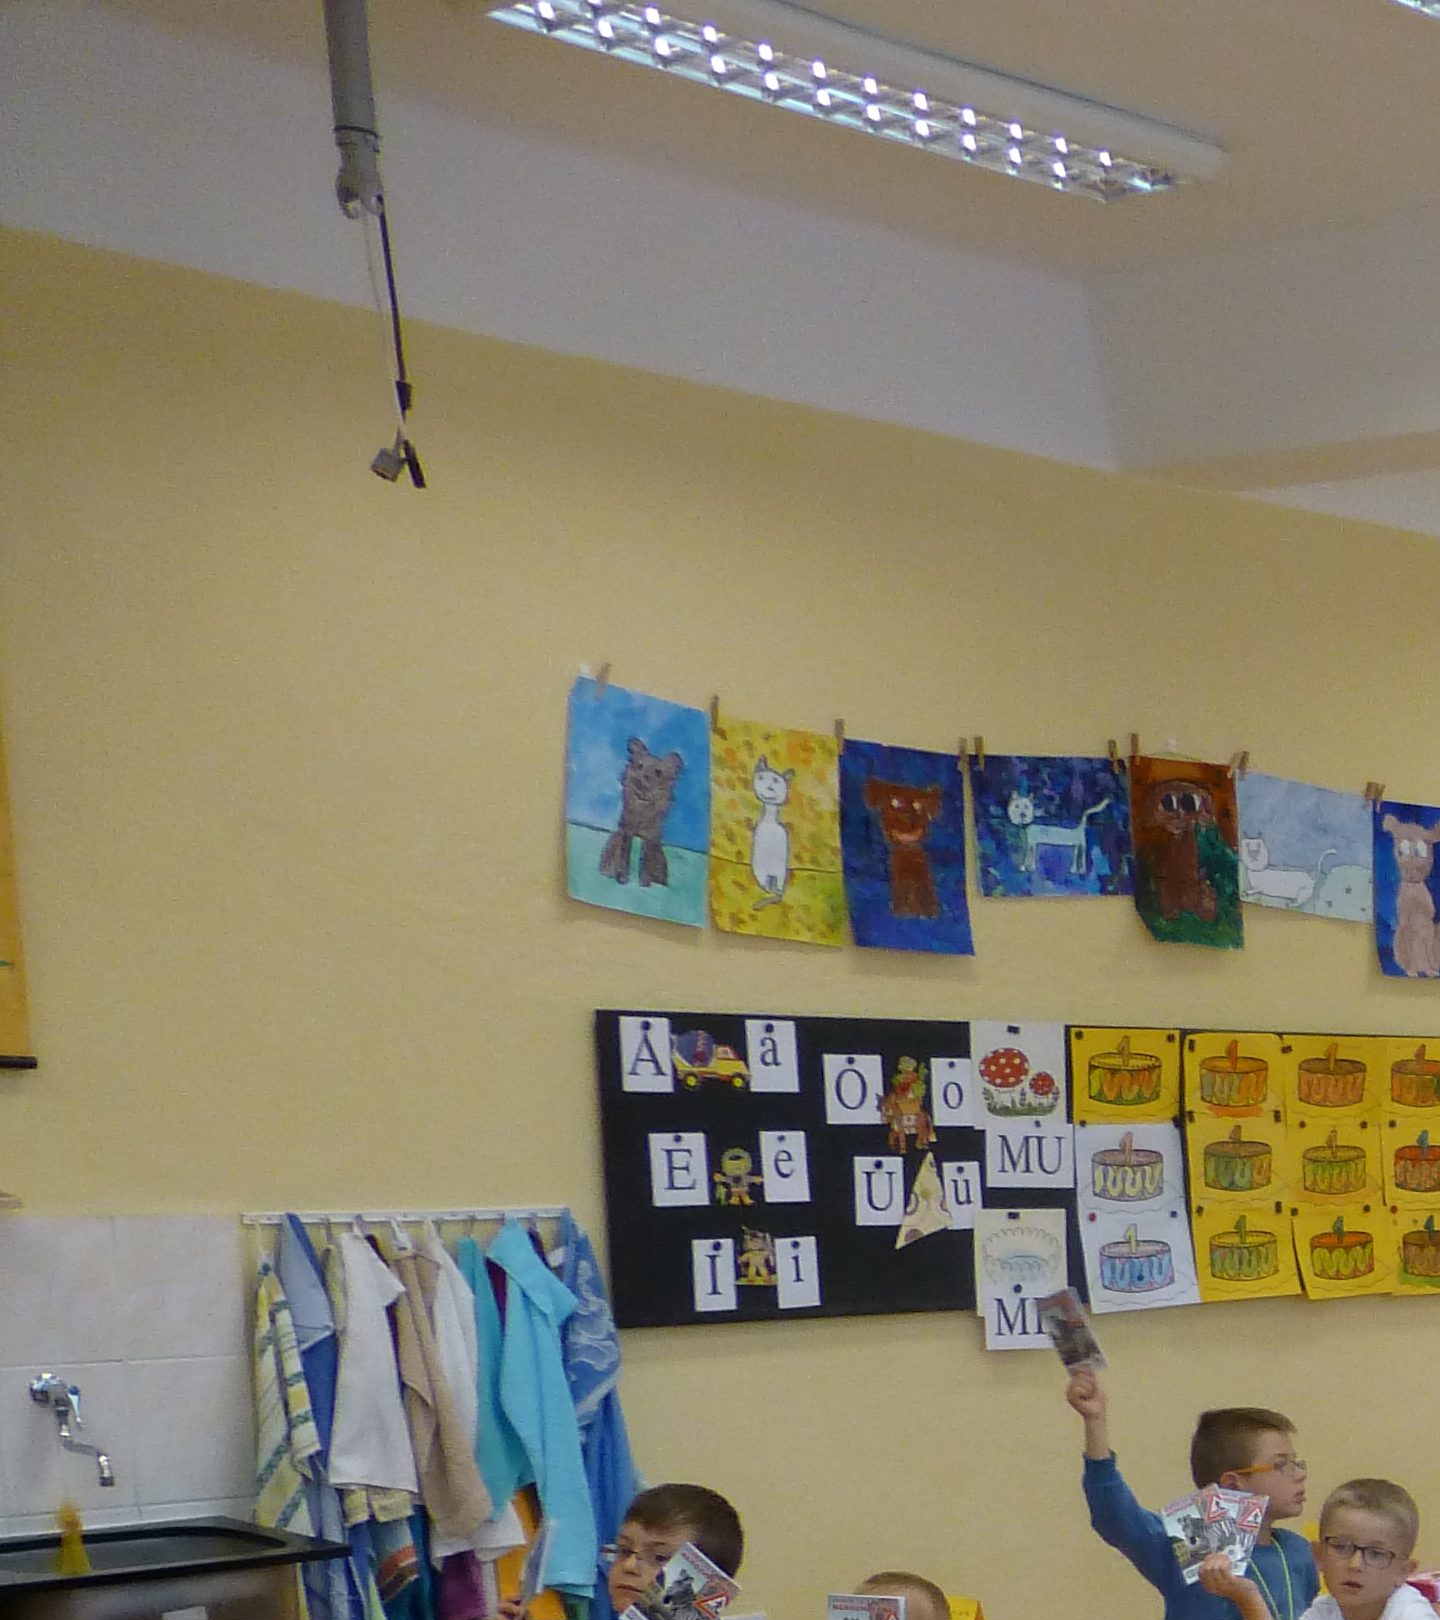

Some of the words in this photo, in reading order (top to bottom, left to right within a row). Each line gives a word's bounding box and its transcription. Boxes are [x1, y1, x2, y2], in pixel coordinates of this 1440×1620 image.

[629, 1032, 668, 1077] A
[758, 1040, 782, 1068] a
[834, 1068, 867, 1110] O
[942, 1081, 963, 1110] o
[661, 1148, 697, 1191] E
[773, 1150, 795, 1179] e
[997, 1134, 1068, 1176] MU
[862, 1170, 896, 1212] U
[950, 1179, 973, 1207] u
[704, 1254, 724, 1297] I
